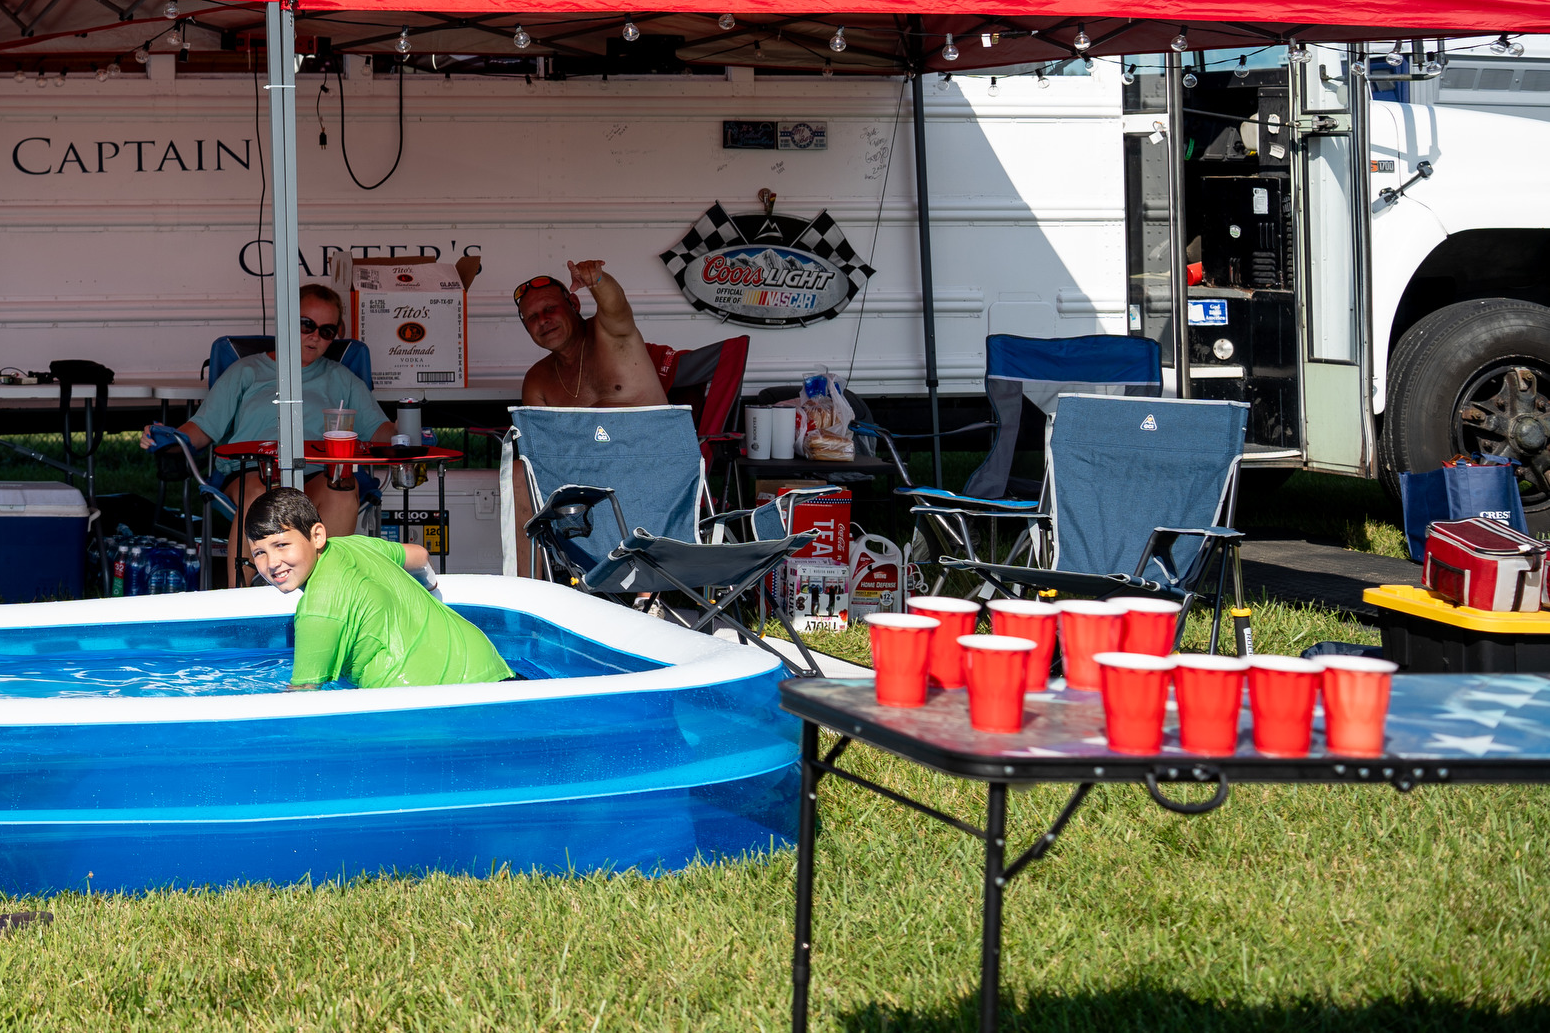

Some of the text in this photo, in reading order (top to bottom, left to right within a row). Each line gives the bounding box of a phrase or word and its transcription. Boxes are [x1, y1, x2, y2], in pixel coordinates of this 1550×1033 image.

[12, 136, 254, 176] CAPTAIN
[702, 254, 836, 290] Coors LIGHT
[716, 287, 743, 296] OFFICIAL
[714, 296, 732, 304] BEER
[765, 290, 816, 309] NASCAR
[388, 345, 436, 356] Handmade
[394, 511, 429, 520] IGOO
